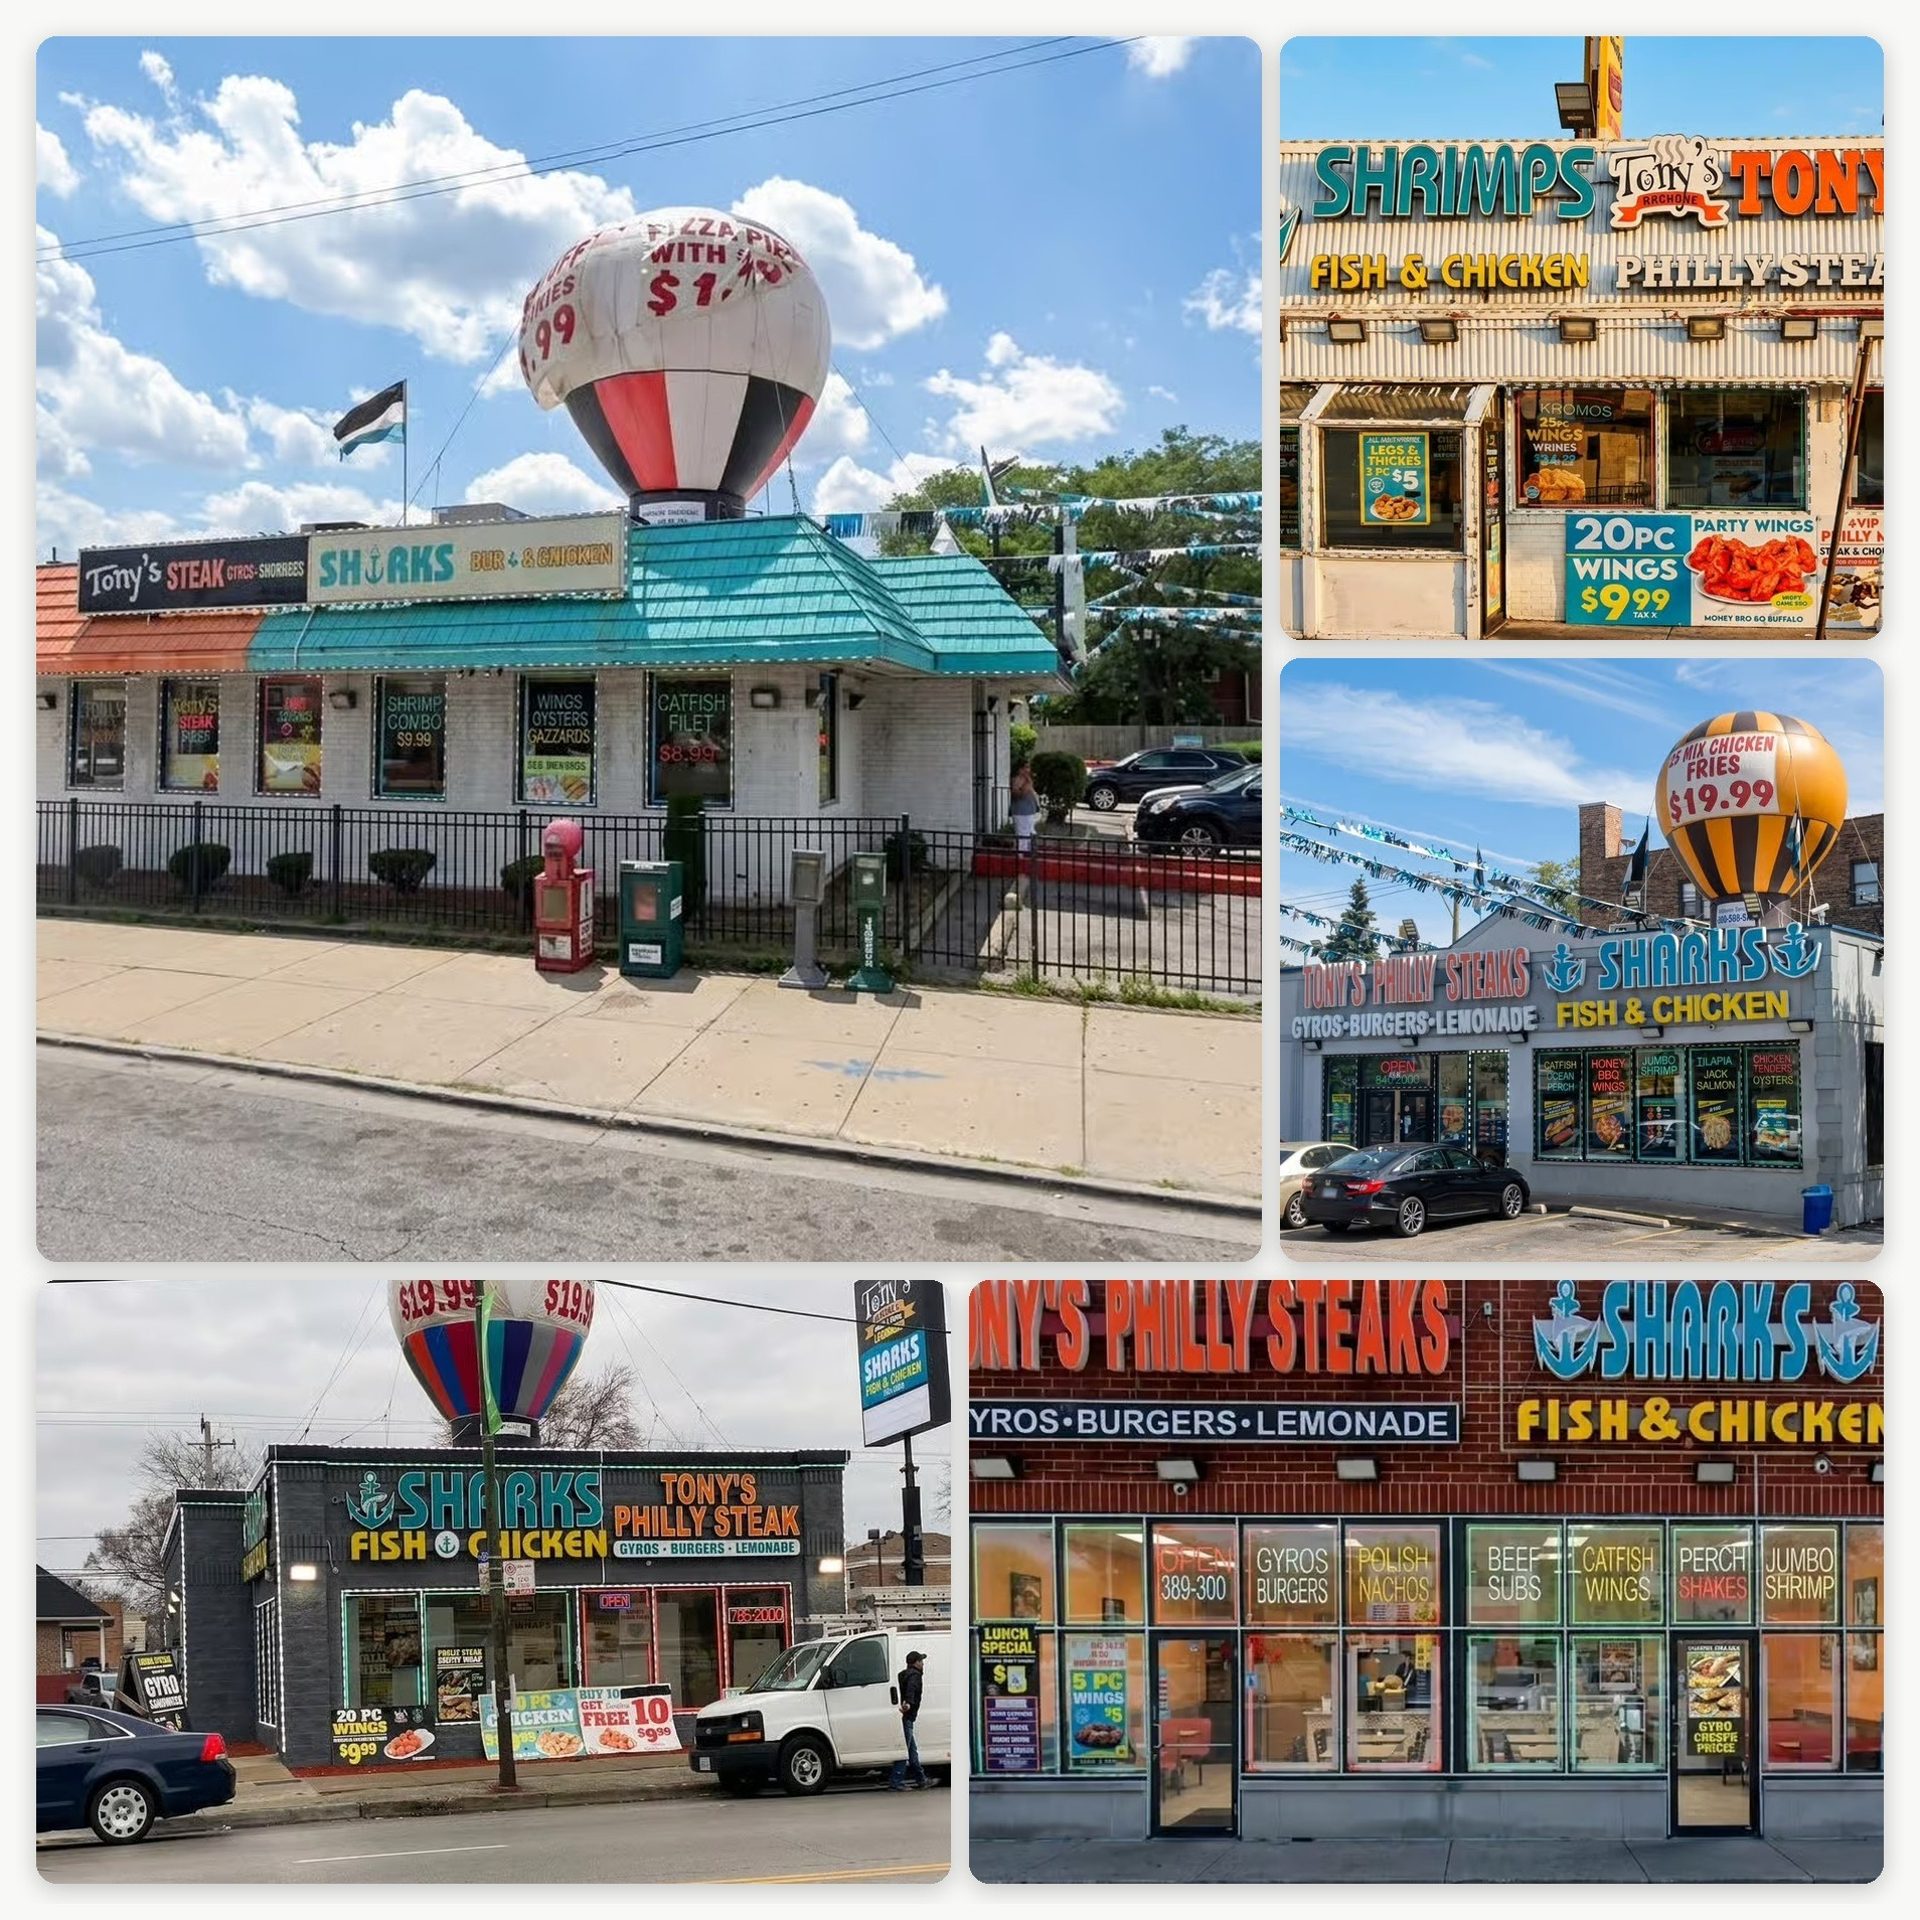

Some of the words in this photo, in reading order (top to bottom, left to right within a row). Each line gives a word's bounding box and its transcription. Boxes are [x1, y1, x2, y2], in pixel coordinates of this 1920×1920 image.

[1313, 143, 1596, 219] SHRIMPS
[1615, 141, 1718, 211] Tony's
[651, 242, 726, 264] WITH
[1311, 253, 1387, 290] FISH
[1399, 253, 1428, 289] &
[1441, 252, 1590, 290] CHICKEN
[1616, 252, 1776, 290] PHILLY
[1540, 403, 1612, 417] KROMOS
[1526, 429, 1584, 441] WINGS
[1371, 445, 1405, 455] LEGS
[1407, 445, 1418, 455] &
[1533, 443, 1578, 452] WRINES
[1368, 456, 1421, 466] THICKES
[1366, 467, 1373, 476] 3
[1376, 467, 1390, 476] PC
[1392, 469, 1419, 490] $5
[1694, 519, 1750, 533] PARTY
[1755, 519, 1815, 533] WINGS
[1821, 530, 1872, 542] PILLY
[522, 547, 534, 568] &
[1820, 547, 1850, 555] STAK
[1852, 547, 1860, 555] &
[85, 553, 162, 602] Tony's
[167, 558, 227, 591] STEAK
[1572, 558, 1679, 582] WINGS
[1767, 615, 1804, 623] BUFFALO
[388, 696, 443, 713] SHRIMP
[537, 694, 583, 710] WINGS
[657, 693, 725, 712] CATFISH
[532, 711, 589, 728] OYSTERS
[669, 714, 715, 733] FILET
[659, 744, 716, 763] $8.99
[1682, 740, 1706, 764] MIX
[1709, 735, 1775, 757] CHICKEN
[1686, 754, 1740, 782] FRIES
[1669, 779, 1774, 823] $19.99
[1303, 961, 1366, 1009] TONY'S
[1372, 954, 1439, 1006] PHILLY
[1446, 946, 1531, 1002] STEAKS
[1598, 926, 1767, 991] SHARKS
[1556, 998, 1618, 1029] FISH
[1624, 996, 1647, 1025] &
[1651, 990, 1790, 1025] CHICKEN
[1292, 1014, 1344, 1039] GYROS
[1349, 1009, 1430, 1038] BURGERS
[1436, 1005, 1539, 1035] LEMONADE
[1380, 1060, 1417, 1074] OPEN
[1544, 1060, 1577, 1070] CATFISH
[1591, 1058, 1626, 1069] HONEY
[1642, 1055, 1676, 1066] JUMBO
[1753, 1054, 1791, 1064] CHICKEN
[1597, 1070, 1619, 1081] BBQ
[1640, 1065, 1678, 1076] SHRIMP
[1703, 1069, 1728, 1079] JACK
[1753, 1064, 1793, 1074] TENDERS
[1547, 1082, 1575, 1092] PERCH
[1592, 1081, 1625, 1092] WINGS
[1696, 1080, 1735, 1091] SALMON
[1753, 1075, 1794, 1086] OYSTERS
[1105, 1280, 1256, 1373] PHILLY
[1266, 1280, 1450, 1375] STEAKS
[1600, 1280, 1811, 1382] SHARKS
[864, 1333, 920, 1383] SHARKS
[1076, 1408, 1249, 1436] BURGERS
[1257, 1409, 1449, 1437] LEMONADE
[1517, 1399, 1629, 1441] FISH
[1638, 1396, 1681, 1441] &
[660, 1472, 757, 1506] TONY'S
[400, 1471, 604, 1530] SHARKS
[614, 1505, 708, 1538] PHILLY
[714, 1504, 801, 1537] STEAK
[351, 1531, 426, 1561] FISH
[619, 1543, 659, 1555] GYROS
[670, 1542, 725, 1555] BURGERS
[1158, 1546, 1235, 1574] OPEN
[1256, 1547, 1329, 1574] GYROS
[1358, 1546, 1429, 1573] POLISH
[1488, 1546, 1541, 1573] BEEF
[1582, 1546, 1655, 1574] CATFISH
[1679, 1547, 1747, 1573] PERCH
[1765, 1547, 1835, 1574] JUMBO
[1161, 1574, 1227, 1601] 389-300
[1256, 1577, 1329, 1604] BURGERS
[1358, 1576, 1430, 1603] NACHOS
[1487, 1575, 1542, 1602] SUBS
[1585, 1576, 1651, 1602] WINGS
[1678, 1576, 1748, 1601] SHAKES
[1765, 1575, 1836, 1602] SHRIMP
[601, 1595, 629, 1607] OPEN
[984, 1627, 1030, 1641] LUNCH
[981, 1641, 1037, 1655] SPECIAL
[144, 1674, 180, 1698] GYRO
[1072, 1672, 1088, 1690] 5
[1093, 1672, 1123, 1690] PC
[530, 1694, 551, 1709] PC
[579, 1689, 604, 1700] BUY
[606, 1688, 620, 1699] 10
[1073, 1691, 1125, 1705] WINGS
[336, 1709, 357, 1723] 20
[360, 1708, 382, 1722] PC
[486, 1708, 574, 1728] CICKEN
[581, 1701, 604, 1710] GET
[632, 1697, 669, 1725] 10
[582, 1711, 631, 1727] FREE
[1698, 1721, 1732, 1732] GYRO
